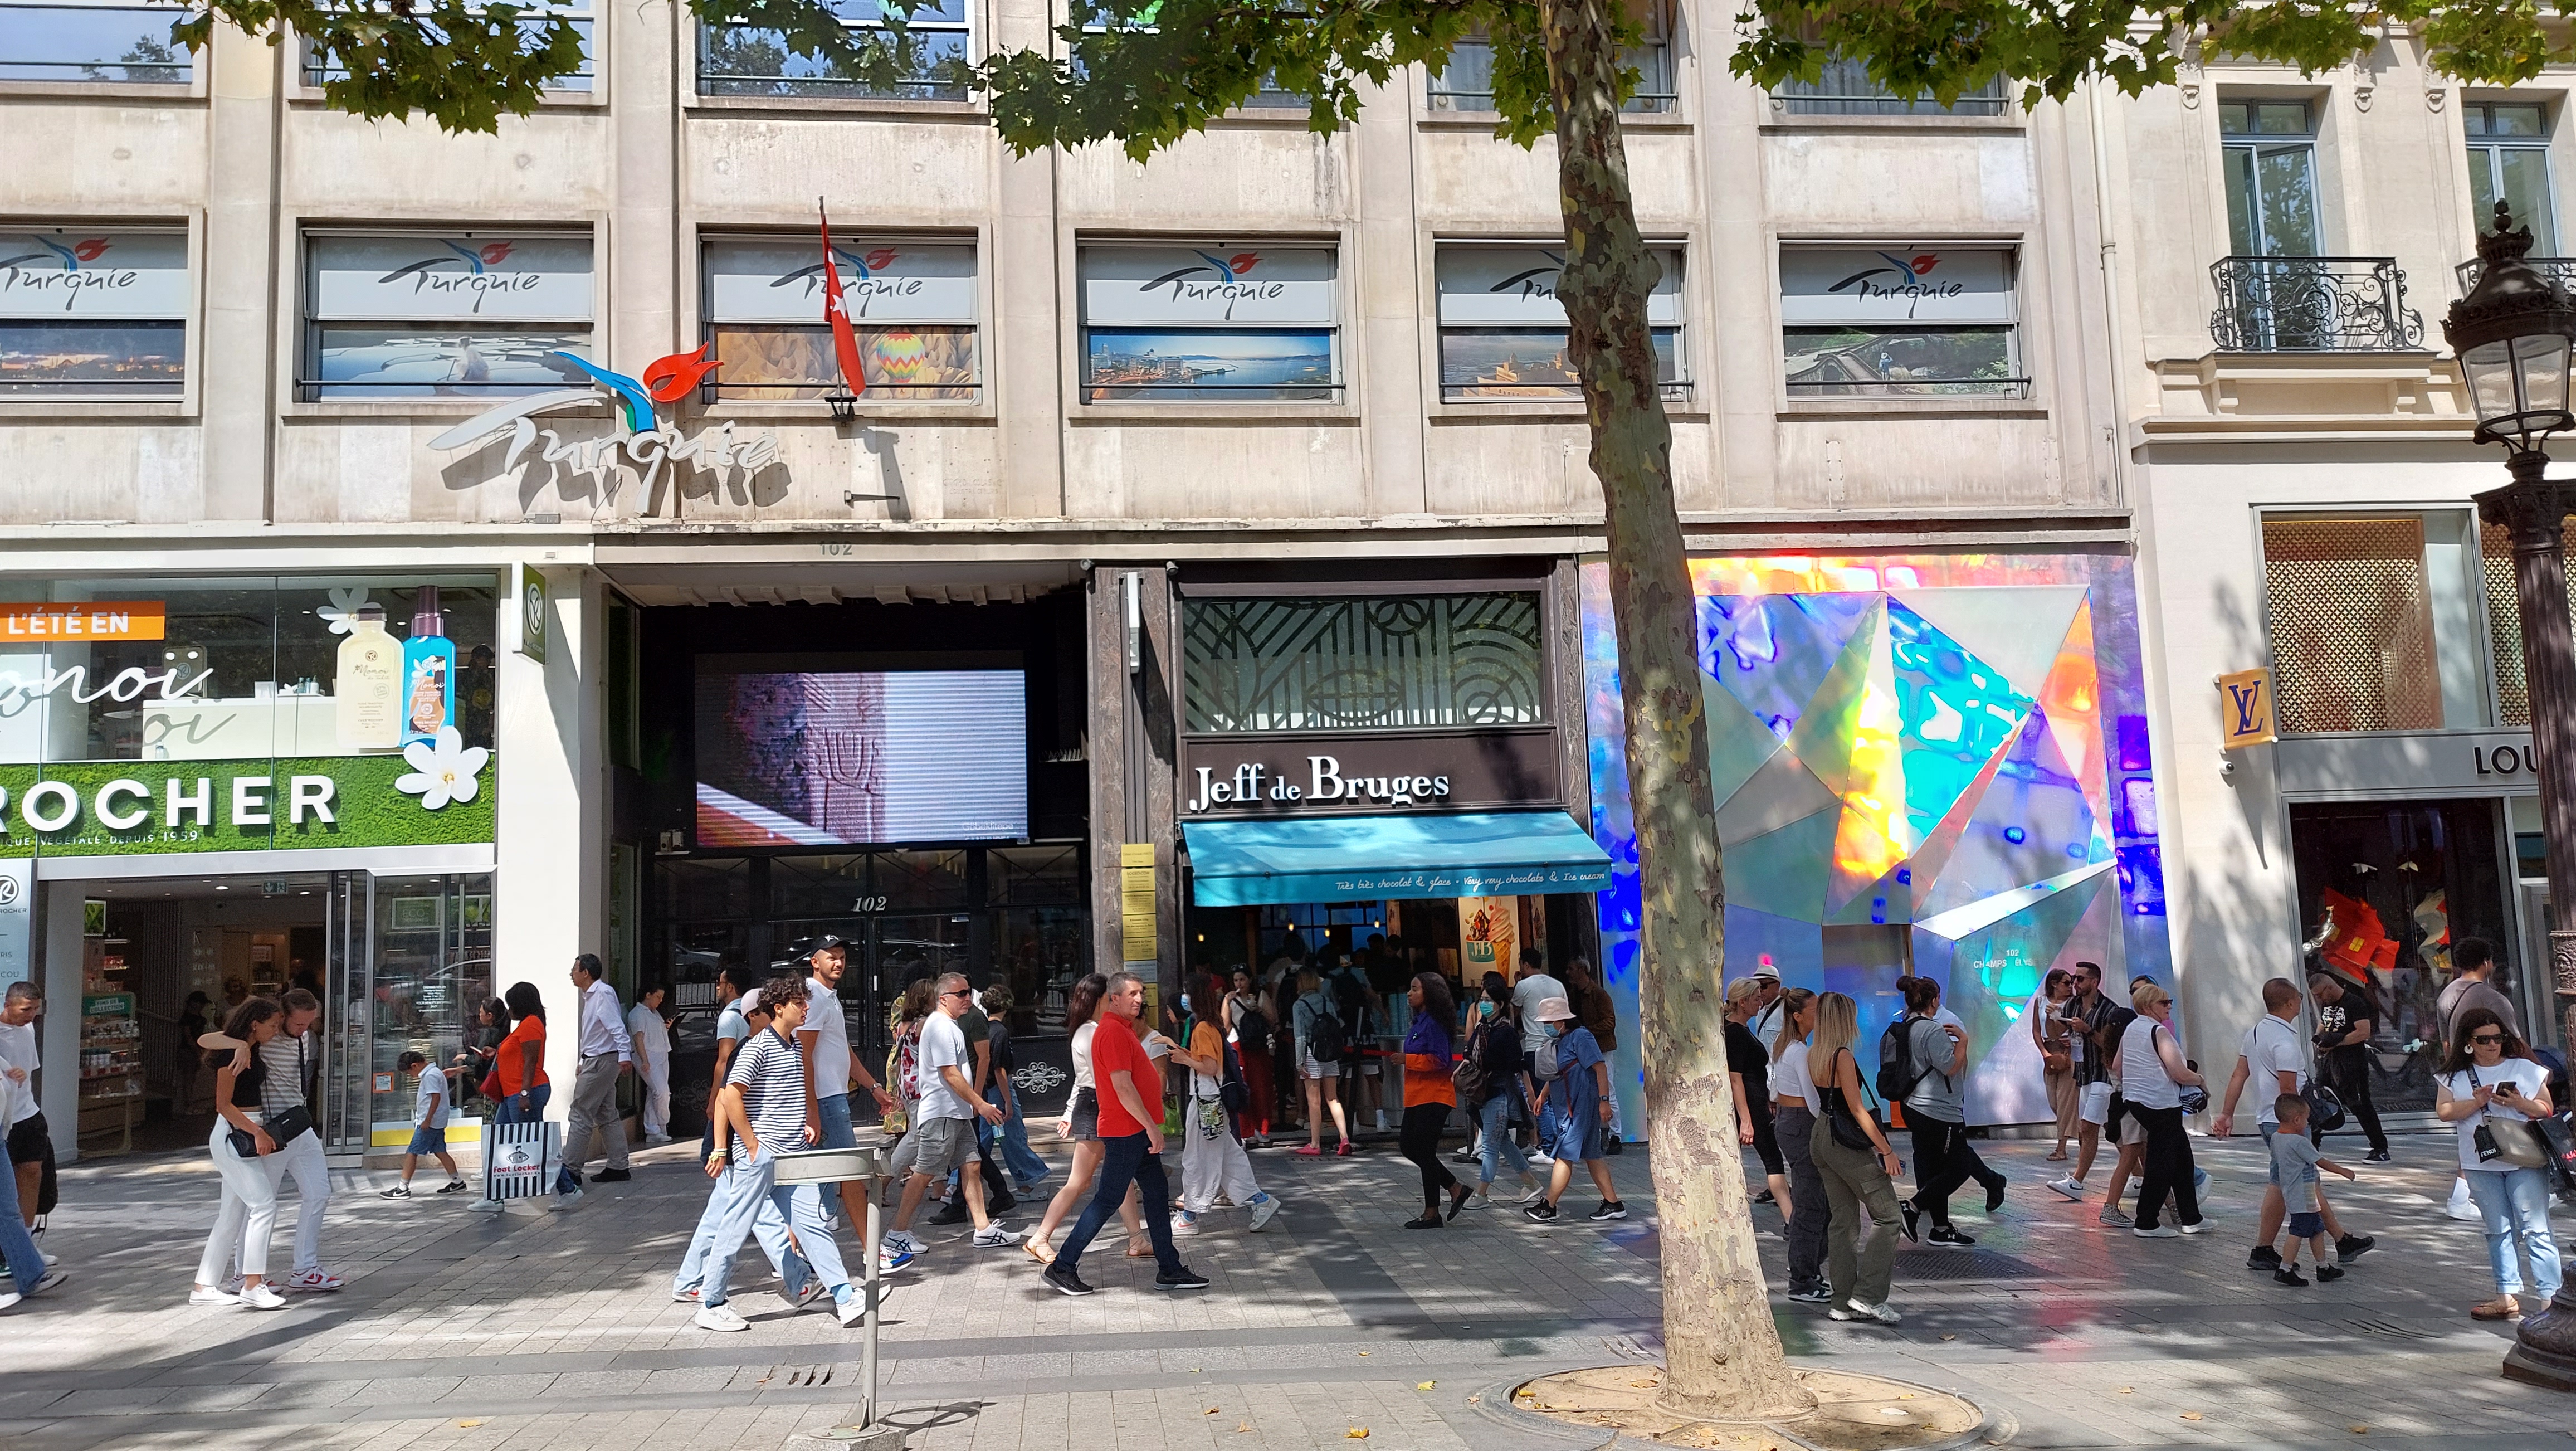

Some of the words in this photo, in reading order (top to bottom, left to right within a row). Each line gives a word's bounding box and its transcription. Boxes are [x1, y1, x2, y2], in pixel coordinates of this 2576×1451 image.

[379, 257, 540, 313] Turquie
[769, 262, 923, 317] Trquie
[1139, 266, 1285, 321] Turquie
[1827, 268, 1963, 319] Turquie
[427, 391, 779, 516] Turquie
[820, 540, 852, 556] 102
[91, 612, 129, 634] EN
[2473, 745, 2538, 775] LOU
[1189, 763, 1266, 811] Jeff
[1270, 776, 1301, 800] de
[1305, 756, 1449, 805] Bruges
[0, 775, 336, 833] OCHER
[164, 830, 198, 842] 1959
[1335, 880, 1354, 890] Très
[1378, 877, 1413, 888] chocolat
[1416, 876, 1426, 887] &
[1428, 875, 1451, 892] glace
[1463, 875, 1484, 893] Very
[1485, 877, 1505, 892] very
[1506, 872, 1544, 884] chocolate
[1549, 871, 1559, 882] &
[1563, 873, 1577, 881] Ice
[852, 896, 887, 912] 102
[1973, 958, 2007, 968] CHAMPS
[2014, 957, 2048, 967] ÉLYSS
[2006, 948, 2019, 957] 102
[2480, 1147, 2497, 1158] FENDI
